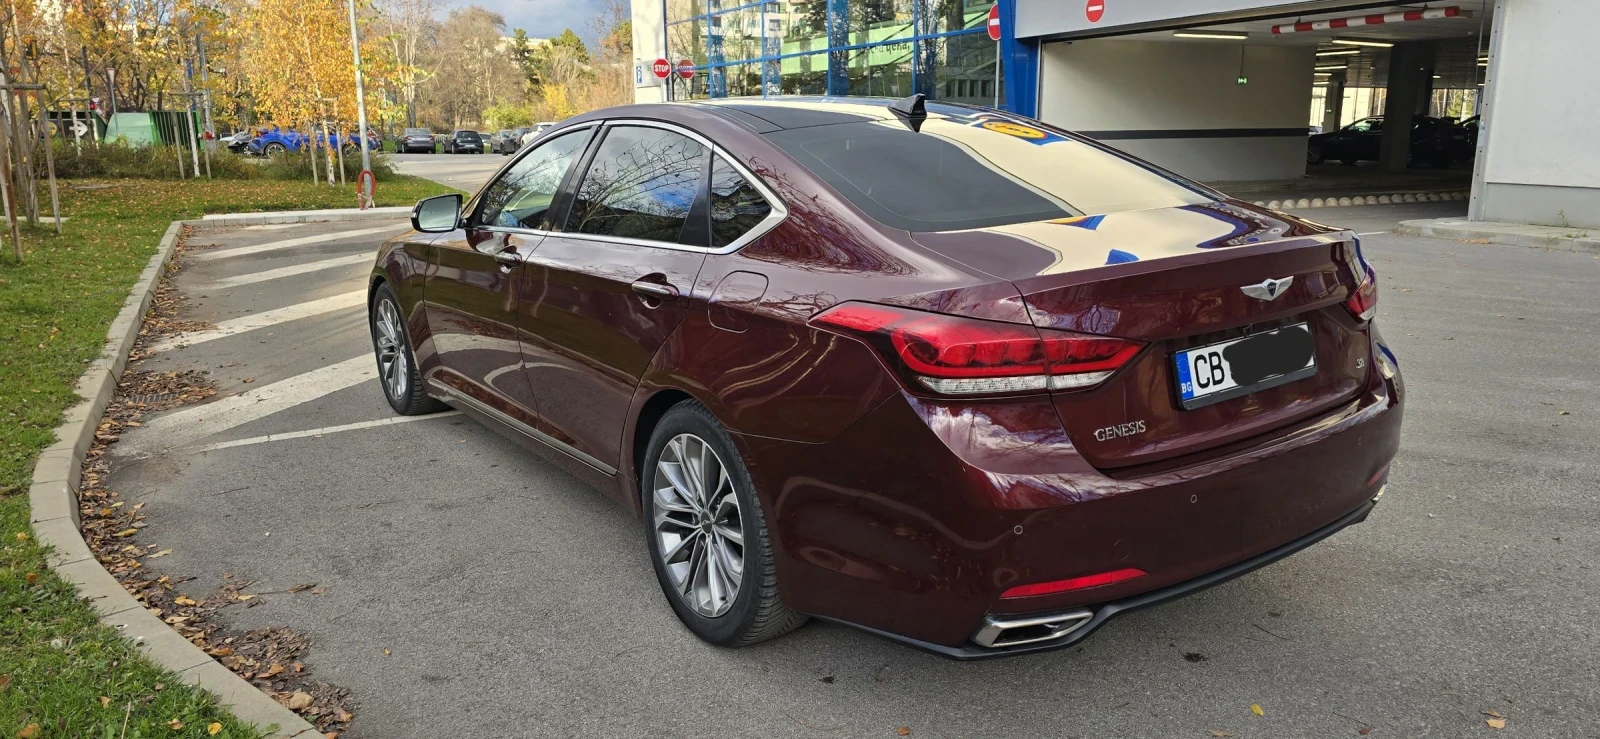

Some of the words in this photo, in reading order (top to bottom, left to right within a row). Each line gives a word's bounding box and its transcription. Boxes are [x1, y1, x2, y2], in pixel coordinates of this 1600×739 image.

[654, 64, 670, 73] STOP
[1194, 351, 1225, 389] CB
[1181, 382, 1192, 394] BG
[1093, 419, 1147, 442] GENESIS
